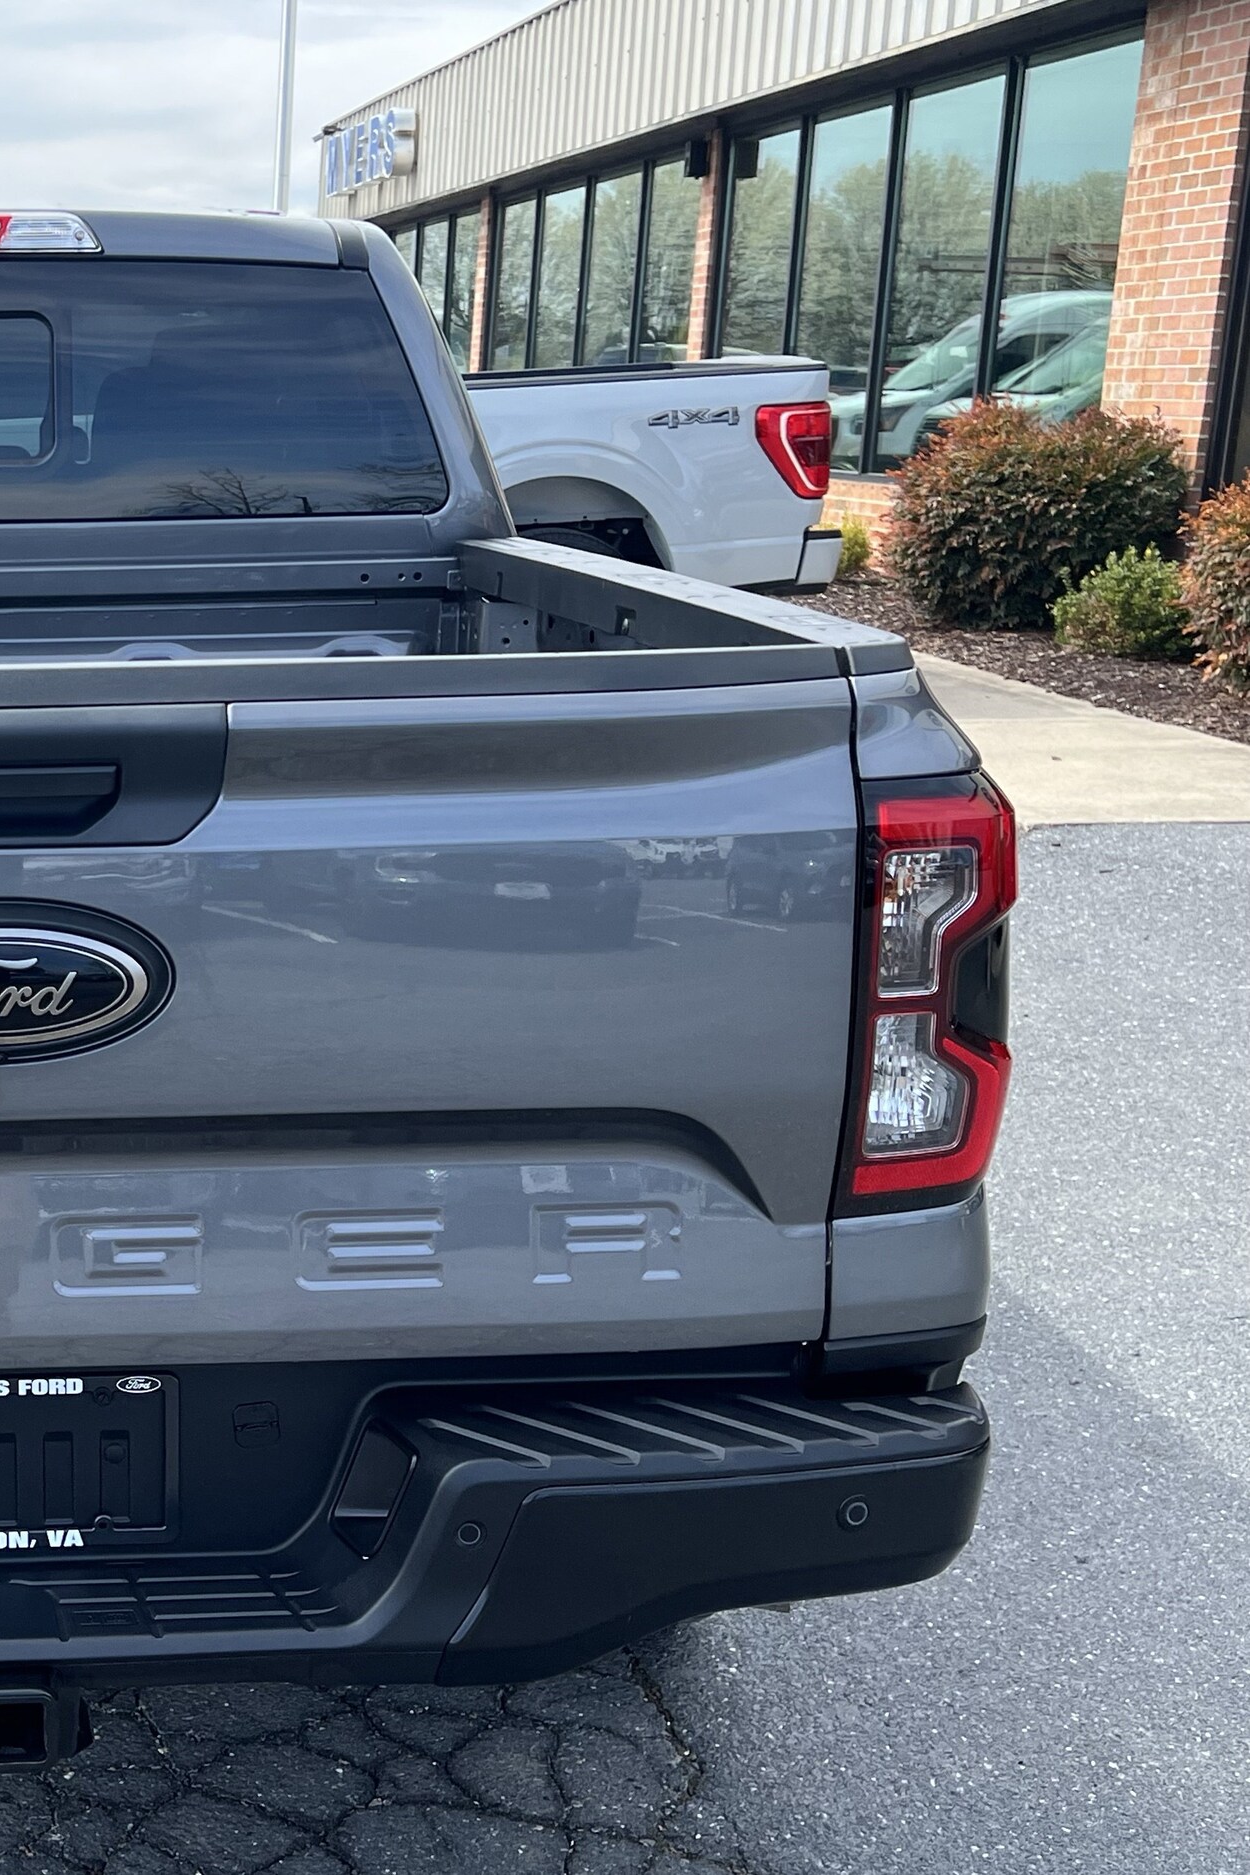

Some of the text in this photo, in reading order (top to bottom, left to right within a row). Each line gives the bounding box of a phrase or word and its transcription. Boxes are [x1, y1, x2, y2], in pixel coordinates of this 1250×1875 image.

[325, 108, 396, 197] MYERS
[18, 1377, 84, 1396] FORD
[125, 1379, 151, 1389] Ford
[46, 1529, 85, 1548] VA
